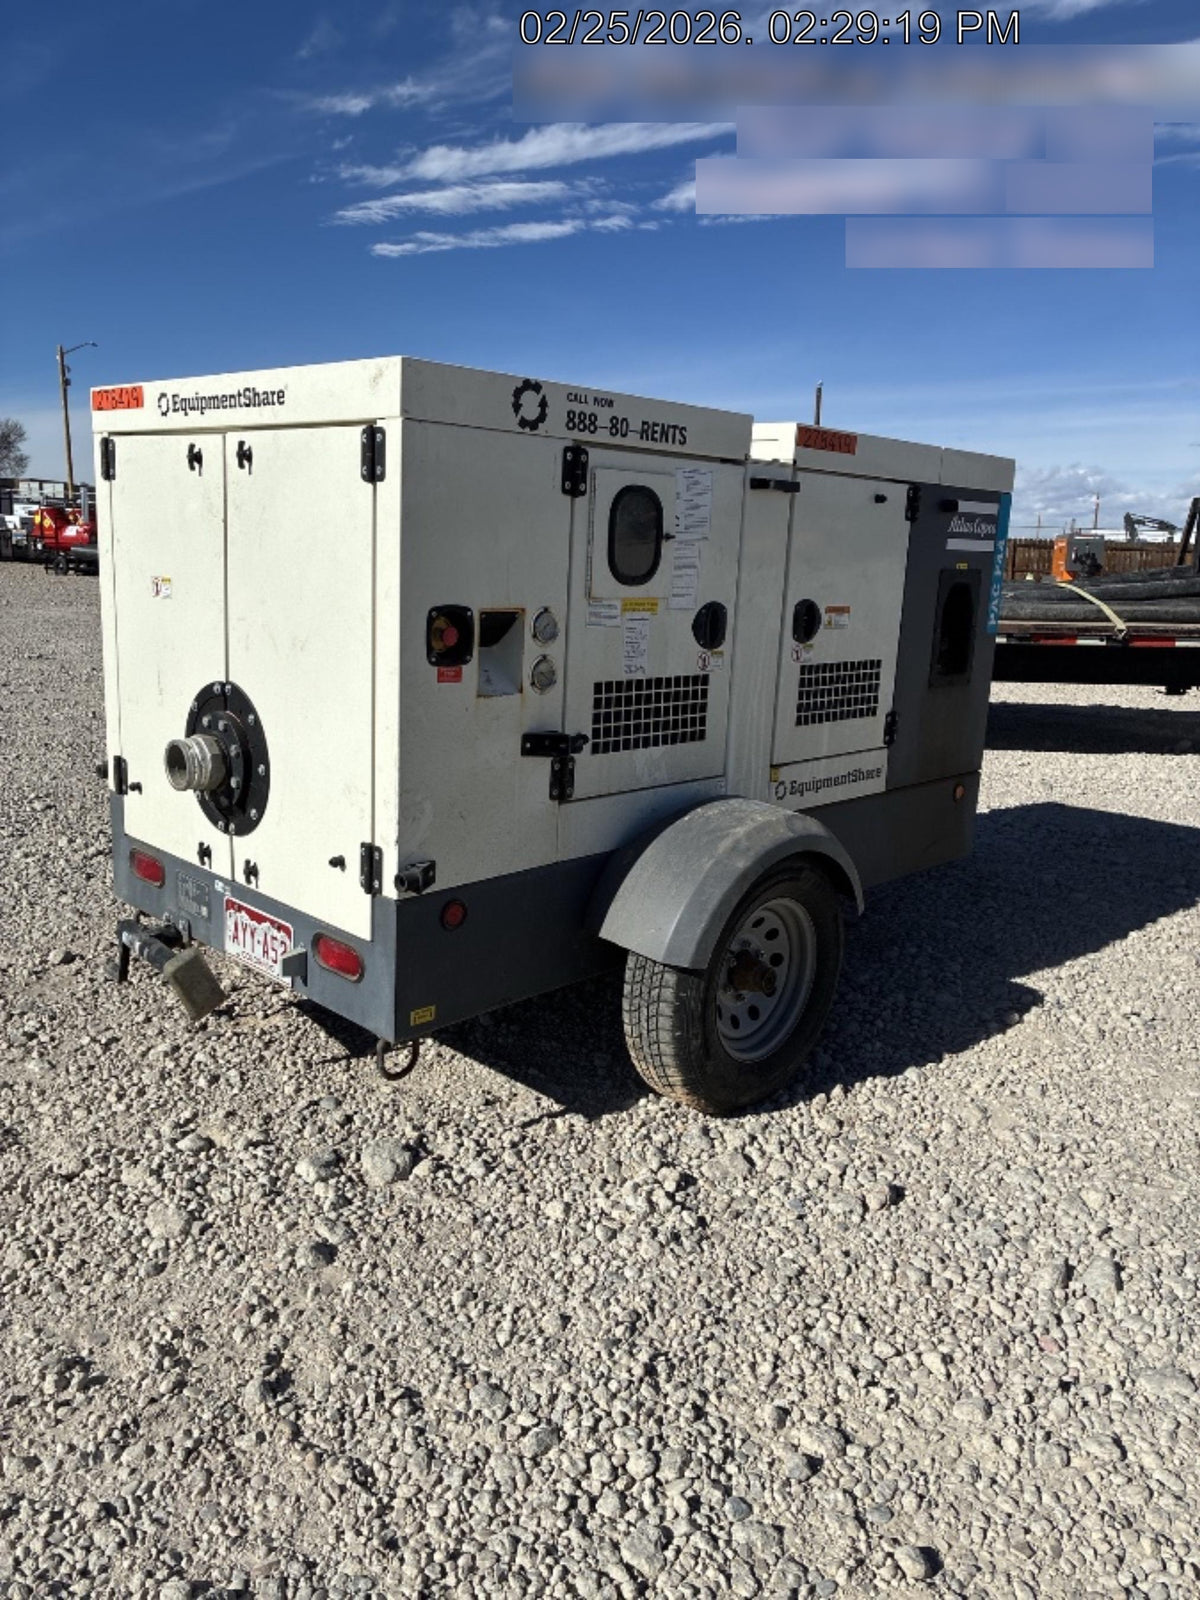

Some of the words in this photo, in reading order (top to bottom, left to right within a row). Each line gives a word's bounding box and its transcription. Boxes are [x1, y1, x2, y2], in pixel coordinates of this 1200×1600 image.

[171, 387, 286, 416] EquipmentShare
[566, 392, 589, 404] CALL
[593, 396, 615, 408] NOW
[789, 767, 883, 797] EquipmentShare
